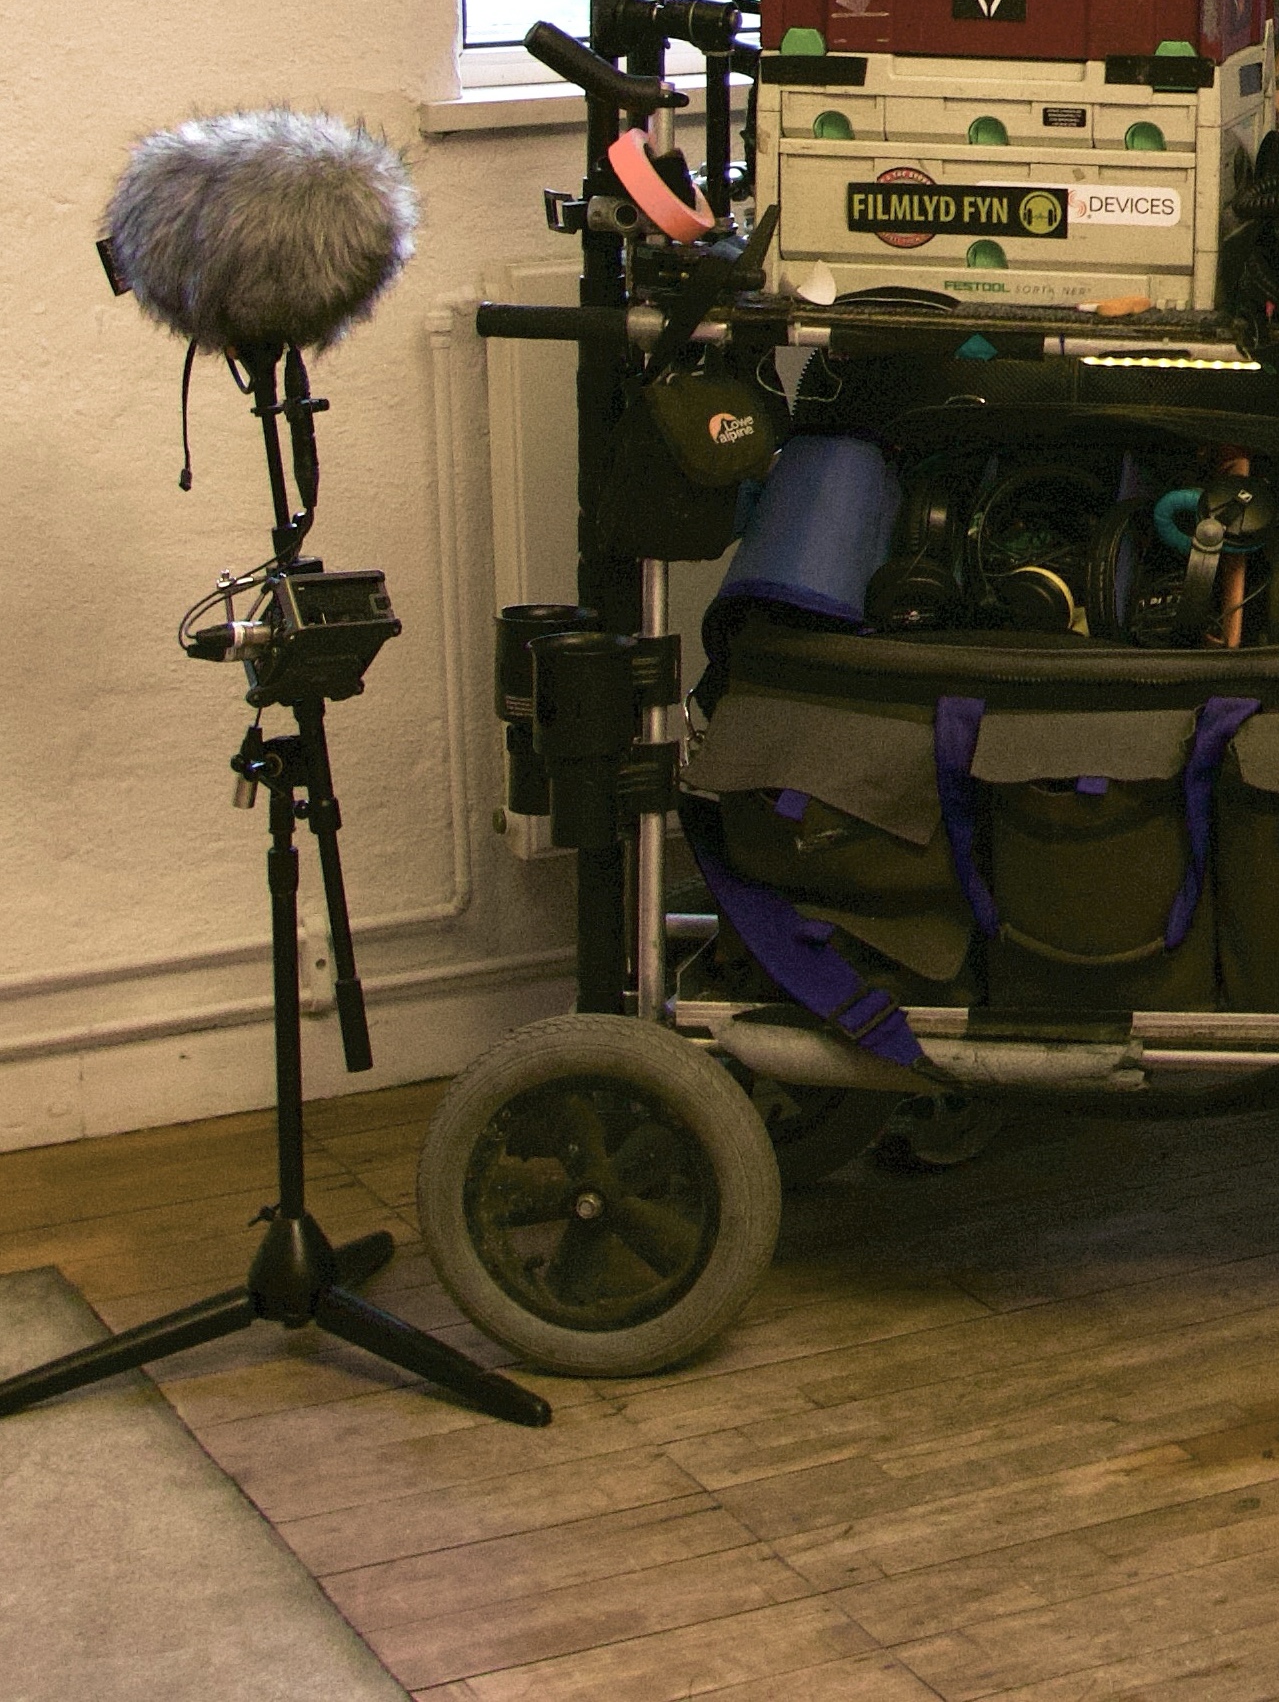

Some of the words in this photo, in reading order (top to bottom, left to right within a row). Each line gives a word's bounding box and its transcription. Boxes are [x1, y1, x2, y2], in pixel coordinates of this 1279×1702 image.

[852, 192, 956, 223] FILMLYD
[963, 196, 1009, 224] FYN
[1089, 196, 1176, 216] DEVICES
[944, 280, 1011, 293] FESTOOL
[722, 416, 754, 431] Lowe
[719, 426, 755, 443] alpine
